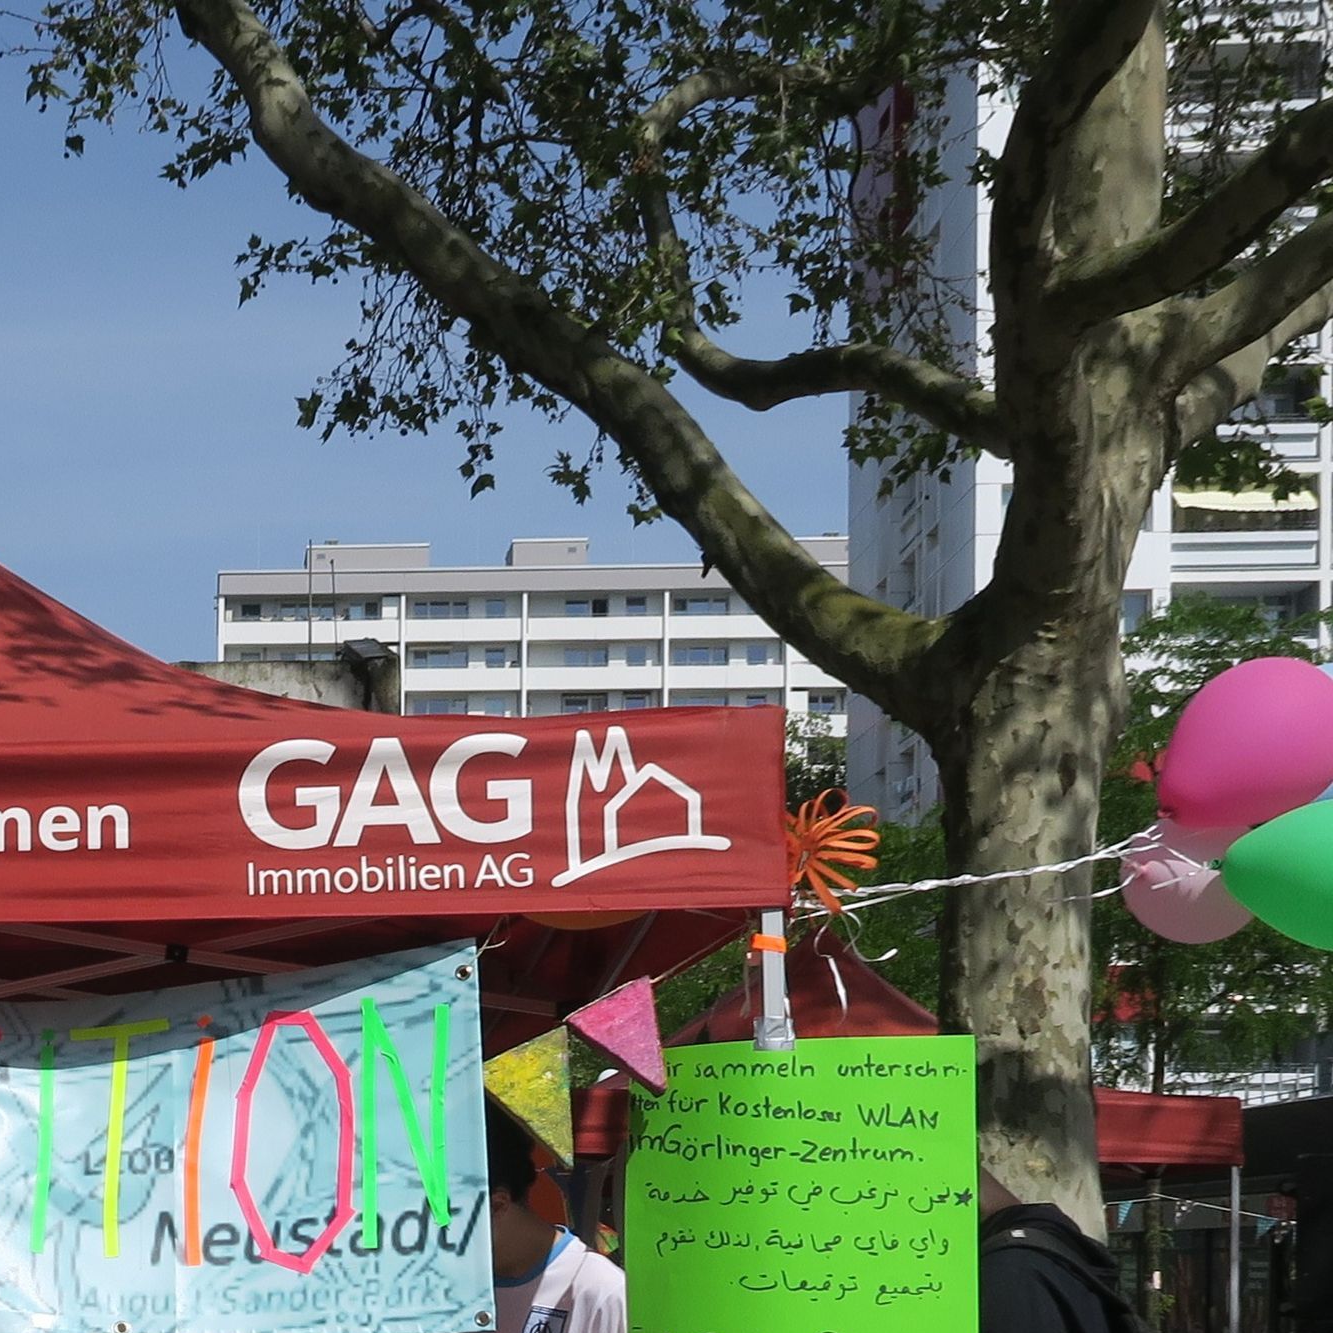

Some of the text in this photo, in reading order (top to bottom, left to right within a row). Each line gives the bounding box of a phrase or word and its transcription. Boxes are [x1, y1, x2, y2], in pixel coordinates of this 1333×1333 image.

[237, 732, 533, 850] GAG
[247, 852, 534, 896] Immobilien AG
[666, 1061, 683, 1078] ir
[694, 1055, 815, 1080] sammeln
[667, 1090, 709, 1113] für
[857, 1102, 939, 1130] WLAN
[787, 1180, 823, 1212] في
